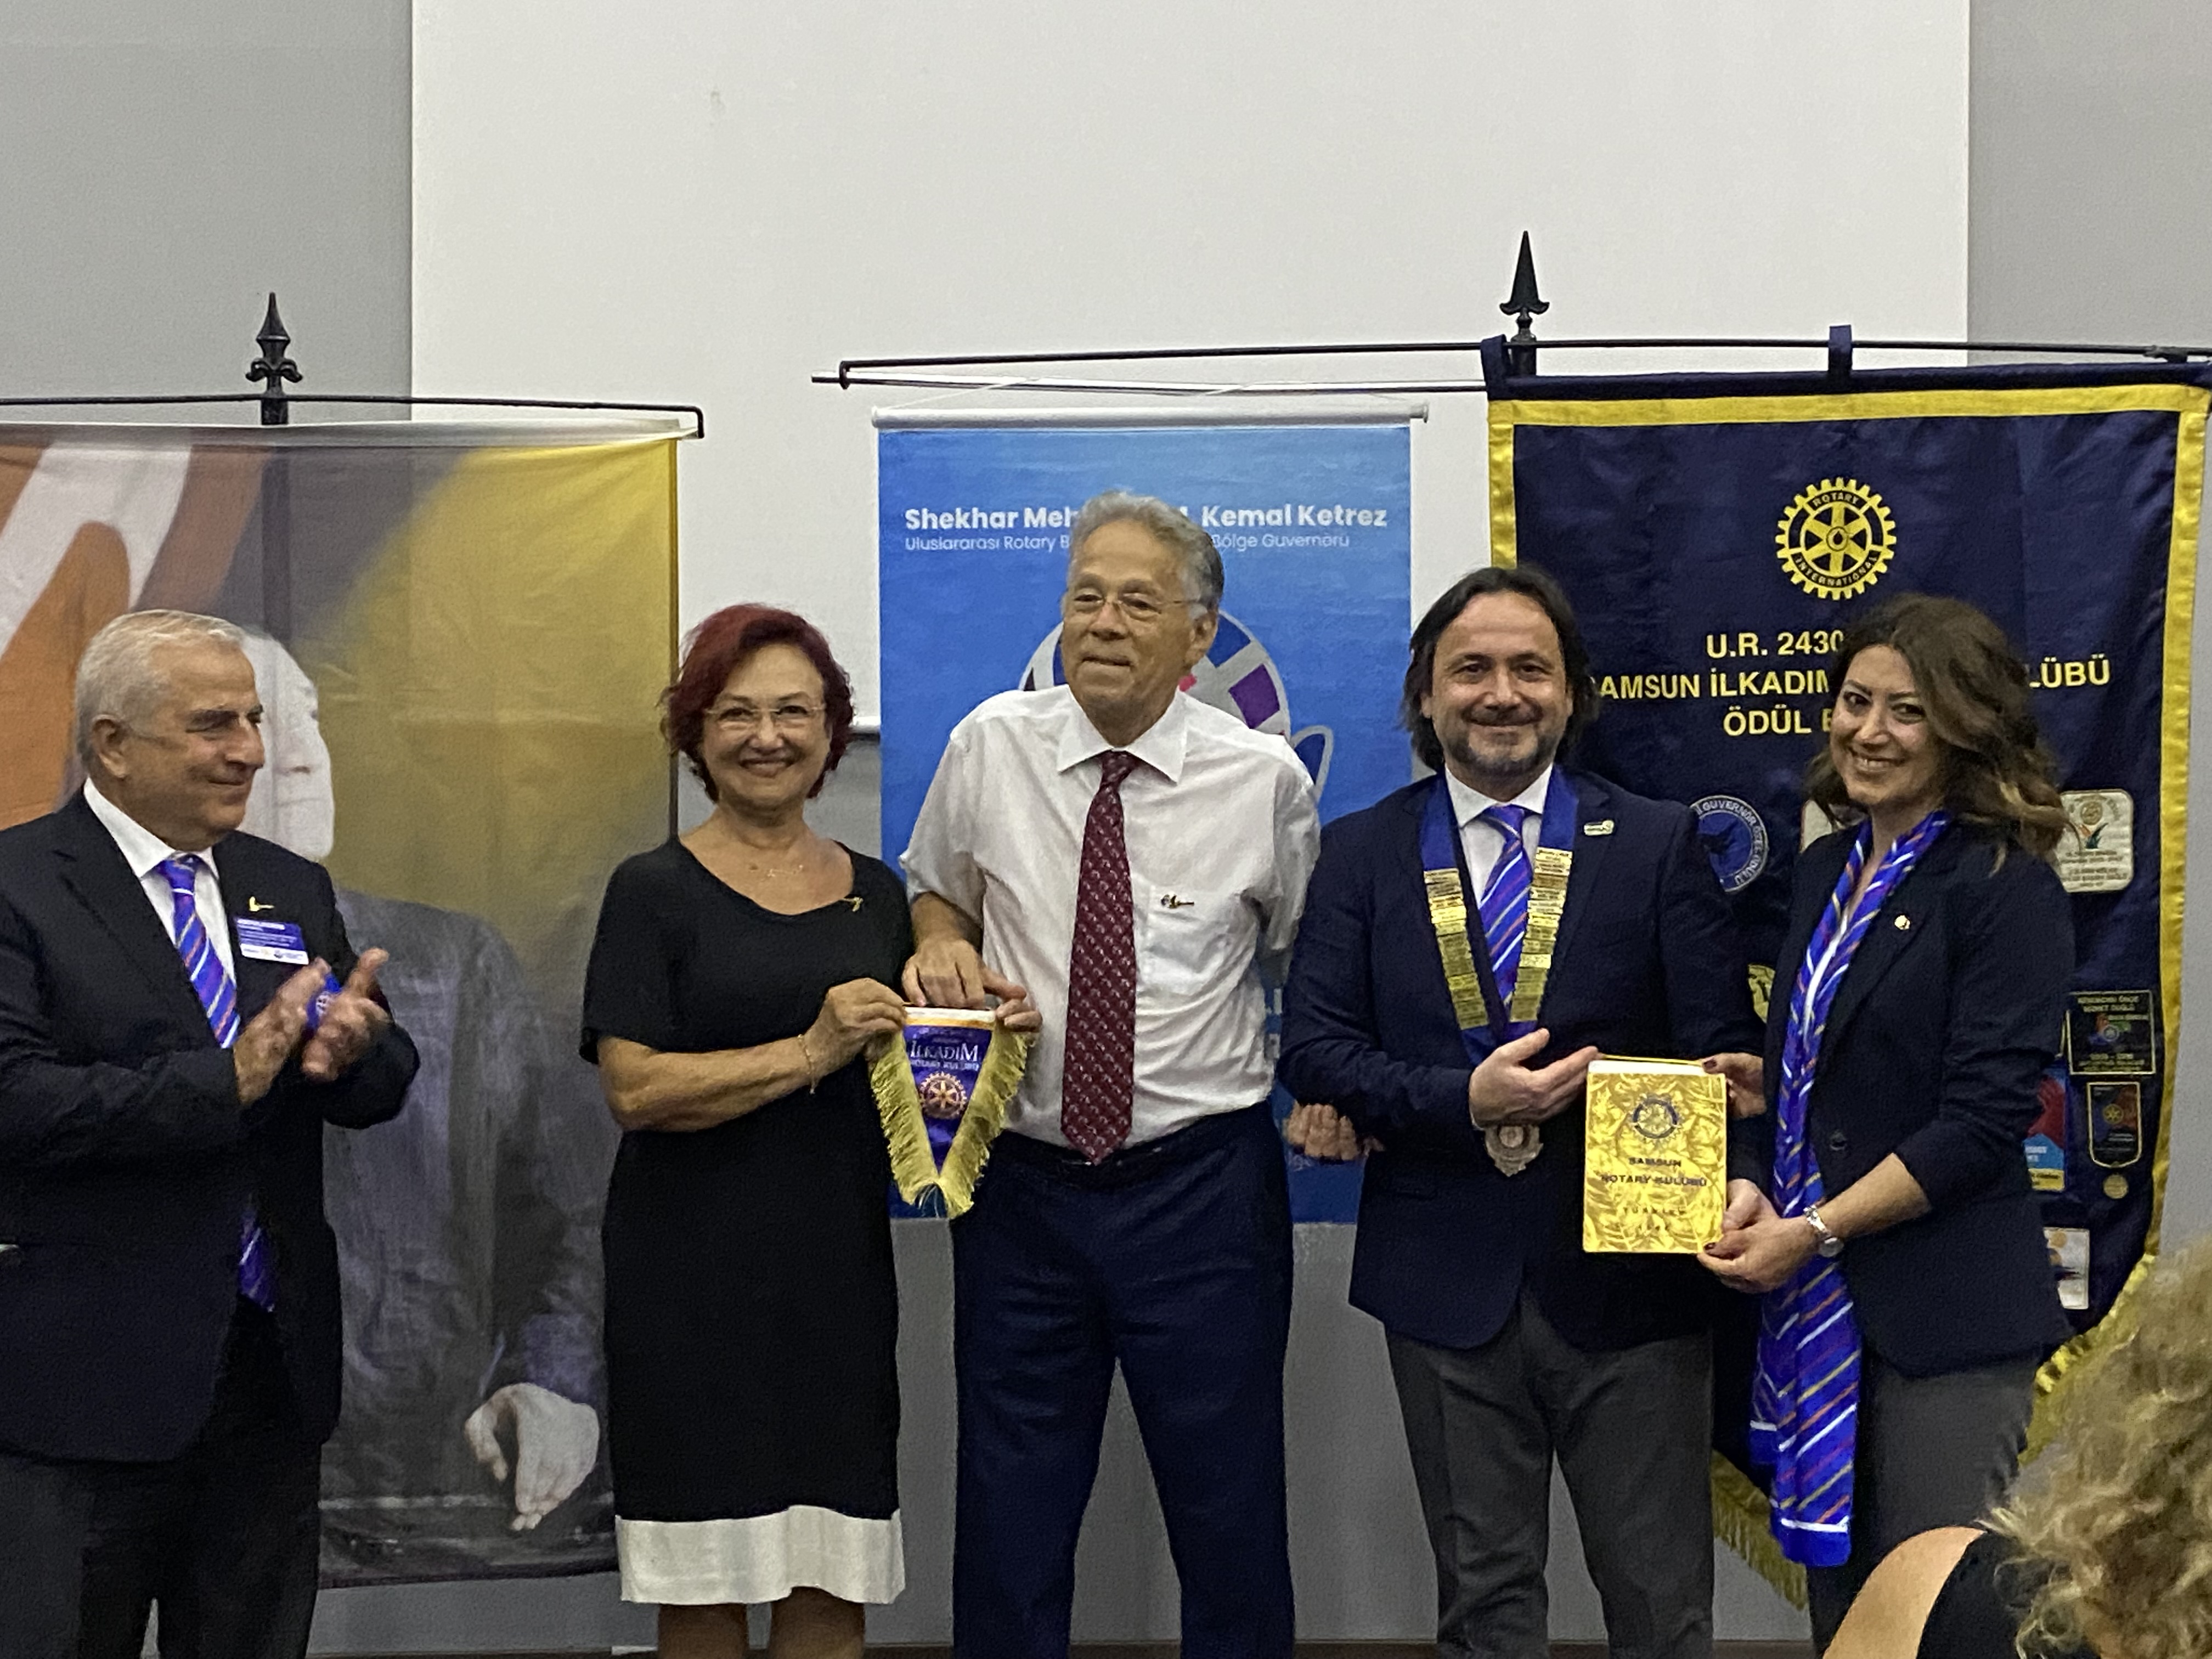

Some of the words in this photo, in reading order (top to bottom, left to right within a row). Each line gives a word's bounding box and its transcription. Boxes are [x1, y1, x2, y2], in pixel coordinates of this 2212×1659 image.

[1812, 493, 1860, 507] ROTARY
[905, 507, 1018, 530] Shekhar
[1024, 506, 1078, 528] Meh
[1201, 504, 1293, 527] Kemal
[1003, 535, 1056, 552] Rotary
[1795, 556, 1877, 586] INTERNATIONAL
[1706, 632, 1768, 658] U.R.
[1590, 674, 1700, 699] AMSUN
[2029, 652, 2111, 688] ÜBÜ
[1723, 704, 1812, 736] ÖDÜL
